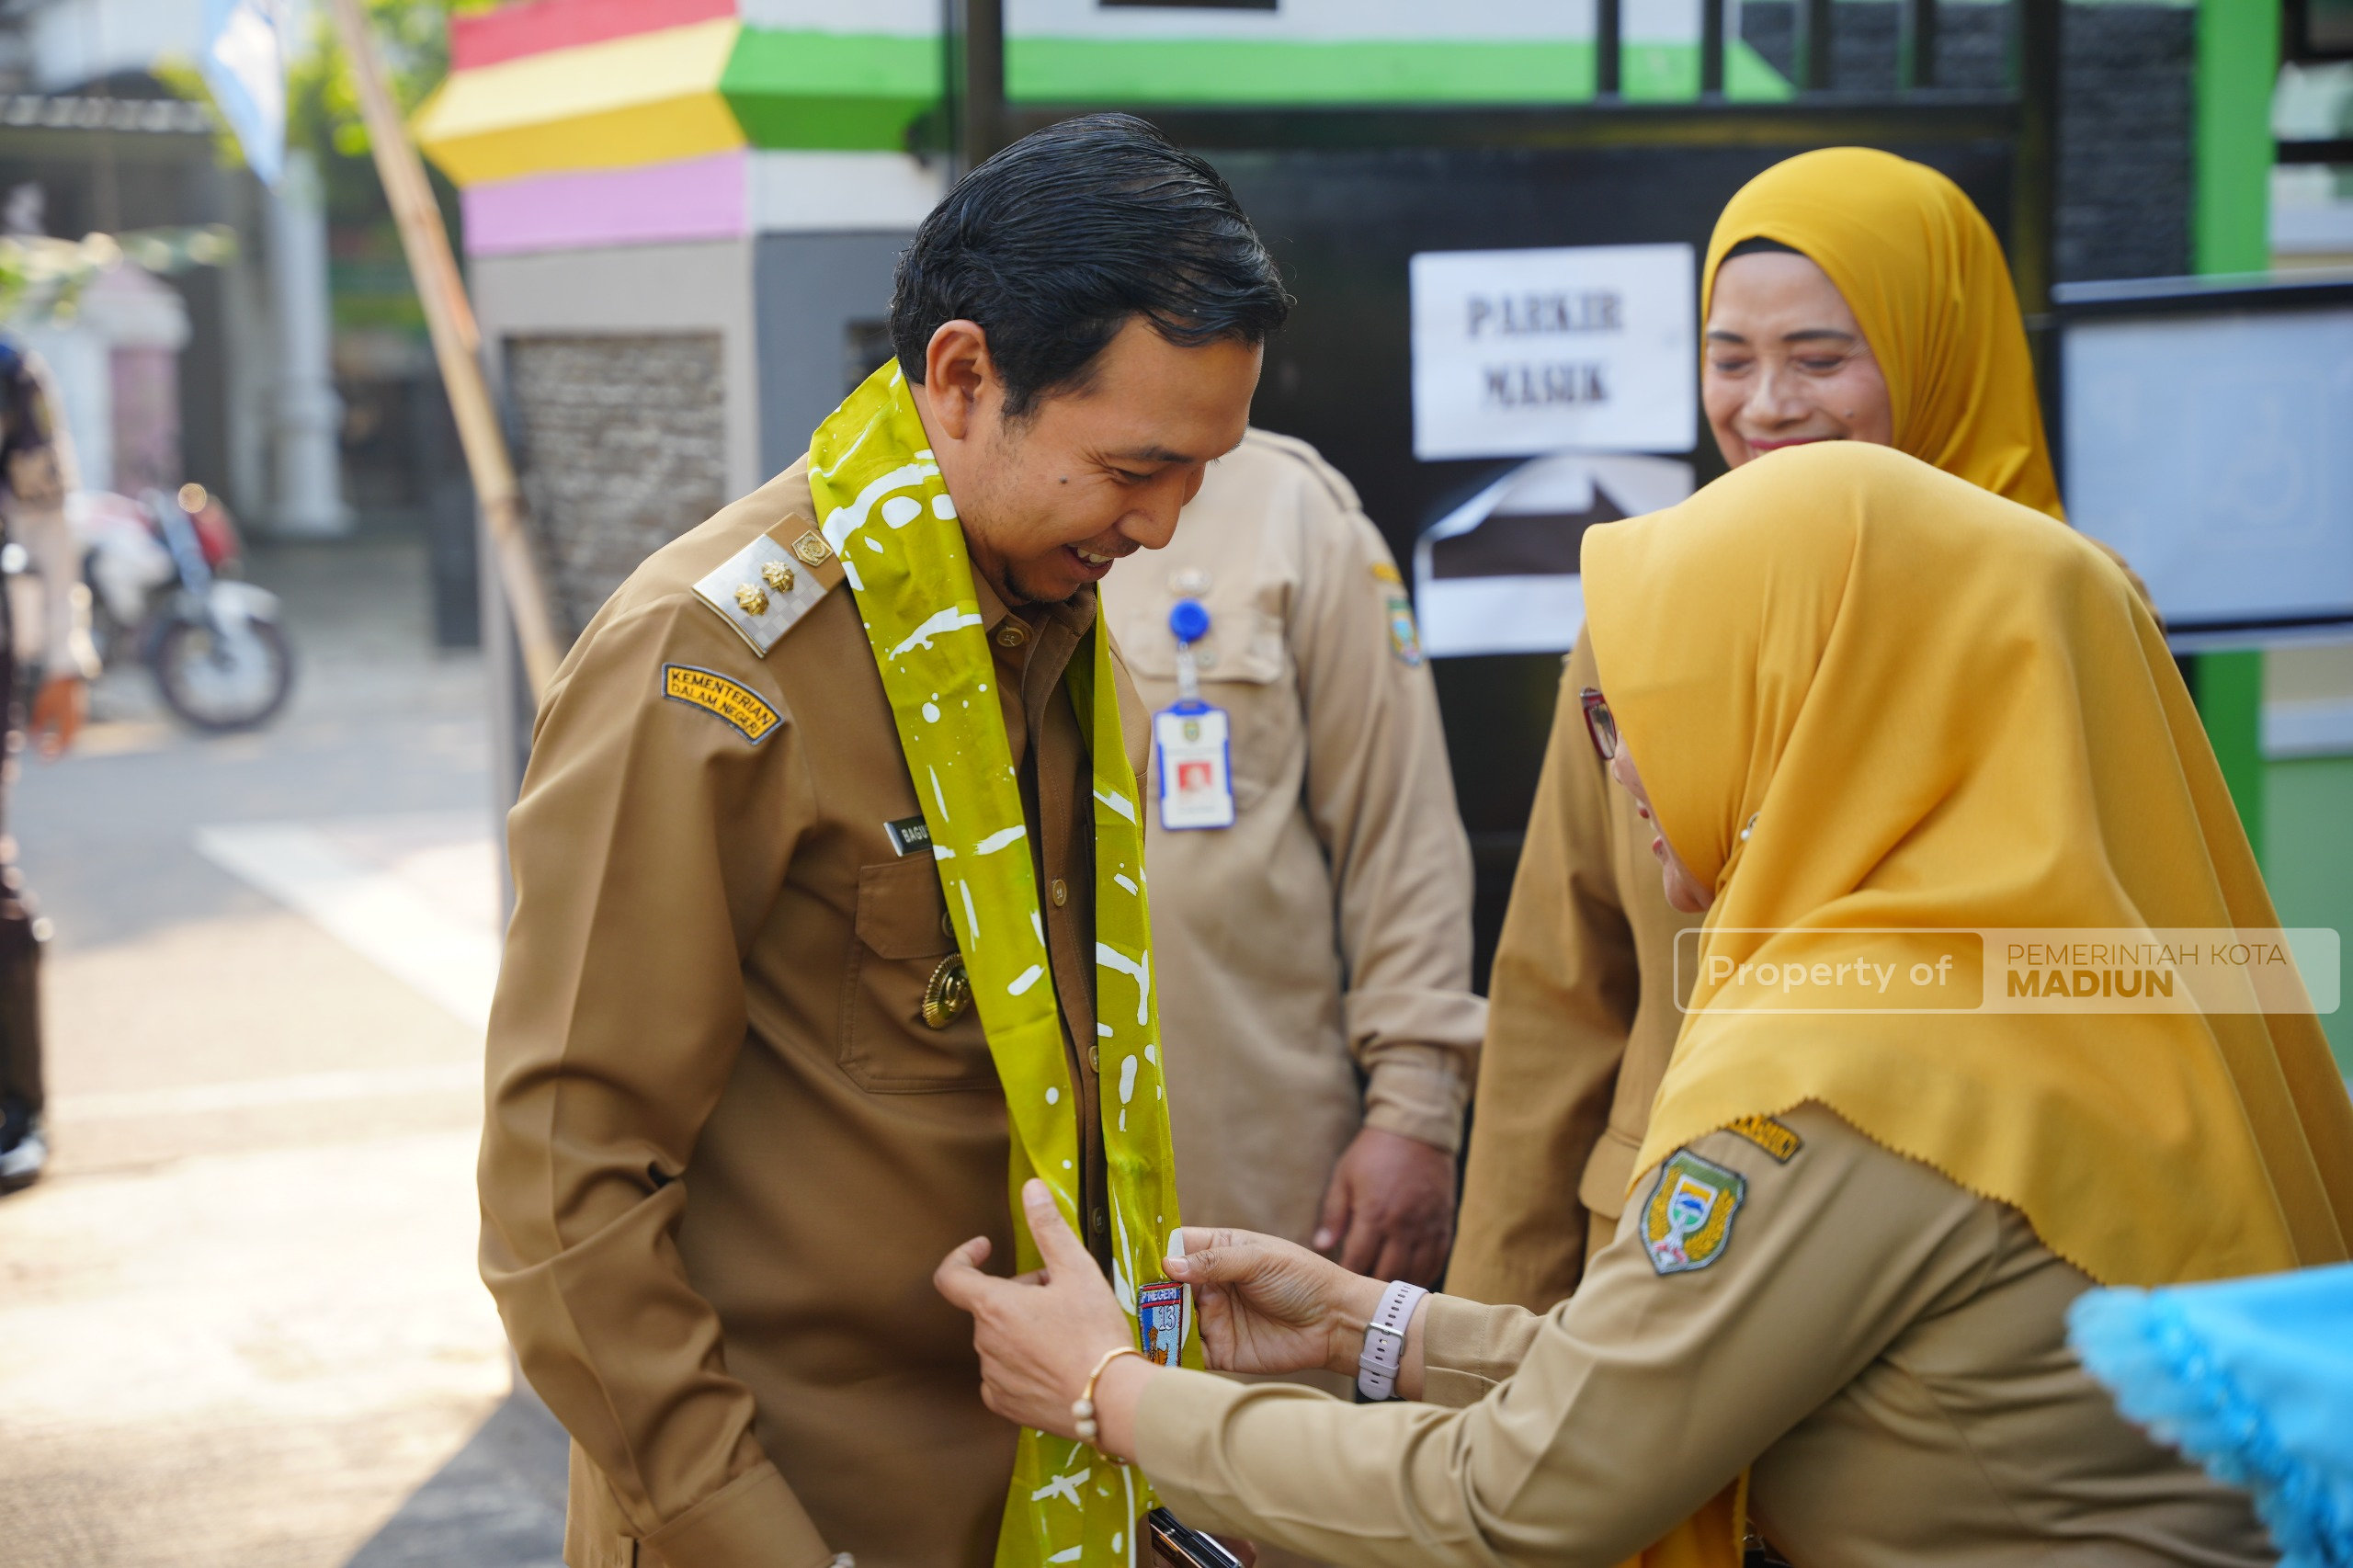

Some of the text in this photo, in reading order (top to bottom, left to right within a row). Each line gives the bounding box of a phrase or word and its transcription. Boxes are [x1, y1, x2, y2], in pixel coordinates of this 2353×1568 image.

[1469, 292, 1622, 336] PARKIR
[1484, 360, 1608, 406] MASUK
[671, 671, 772, 726] KEMENTERIAN
[671, 683, 761, 735] DALAM NEGERI
[901, 825, 928, 843] BAGU
[1159, 1304, 1176, 1331] 13
